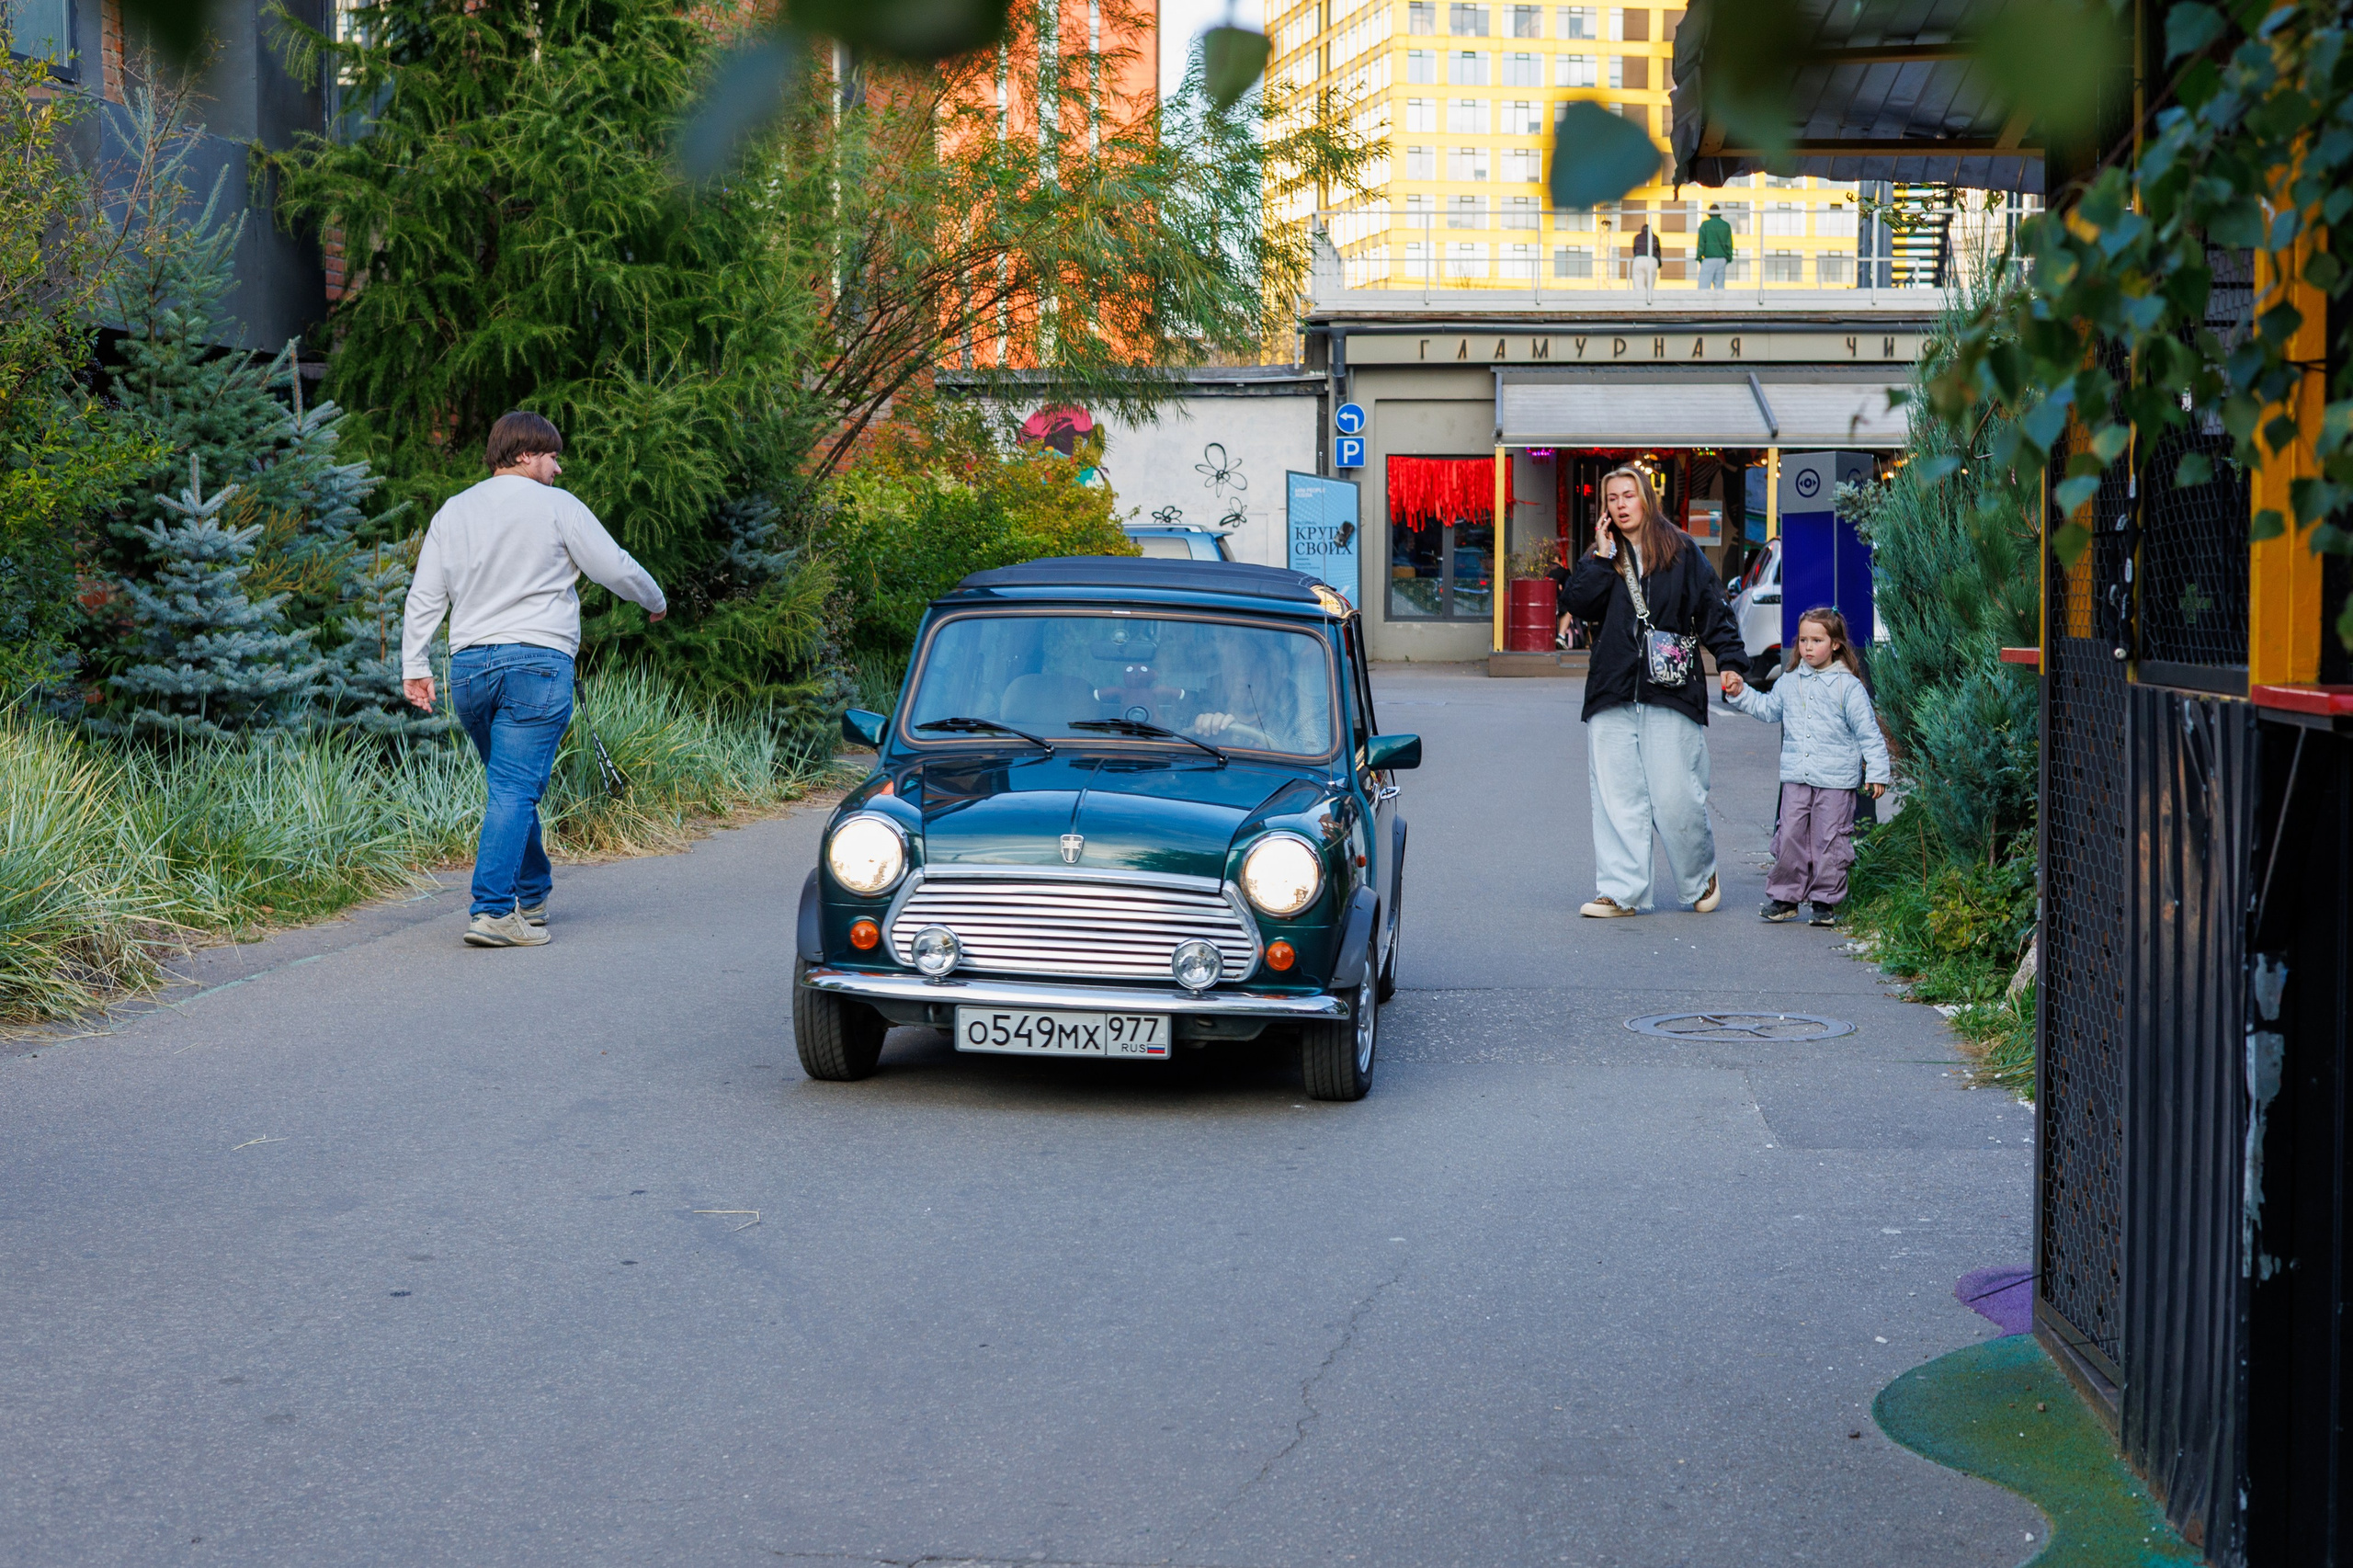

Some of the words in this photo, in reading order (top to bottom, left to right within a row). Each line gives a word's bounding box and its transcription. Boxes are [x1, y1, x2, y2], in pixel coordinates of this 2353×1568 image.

[1419, 337, 1741, 359] ГЛАМУРНАЯ
[1343, 440, 1360, 464] P
[1295, 526, 1338, 540] КРУГ
[1295, 541, 1353, 555] СВОИХ
[1624, 566, 1646, 615] KNOWLEDGE
[1108, 1017, 1159, 1042] 977
[1121, 1043, 1146, 1053] RUS
